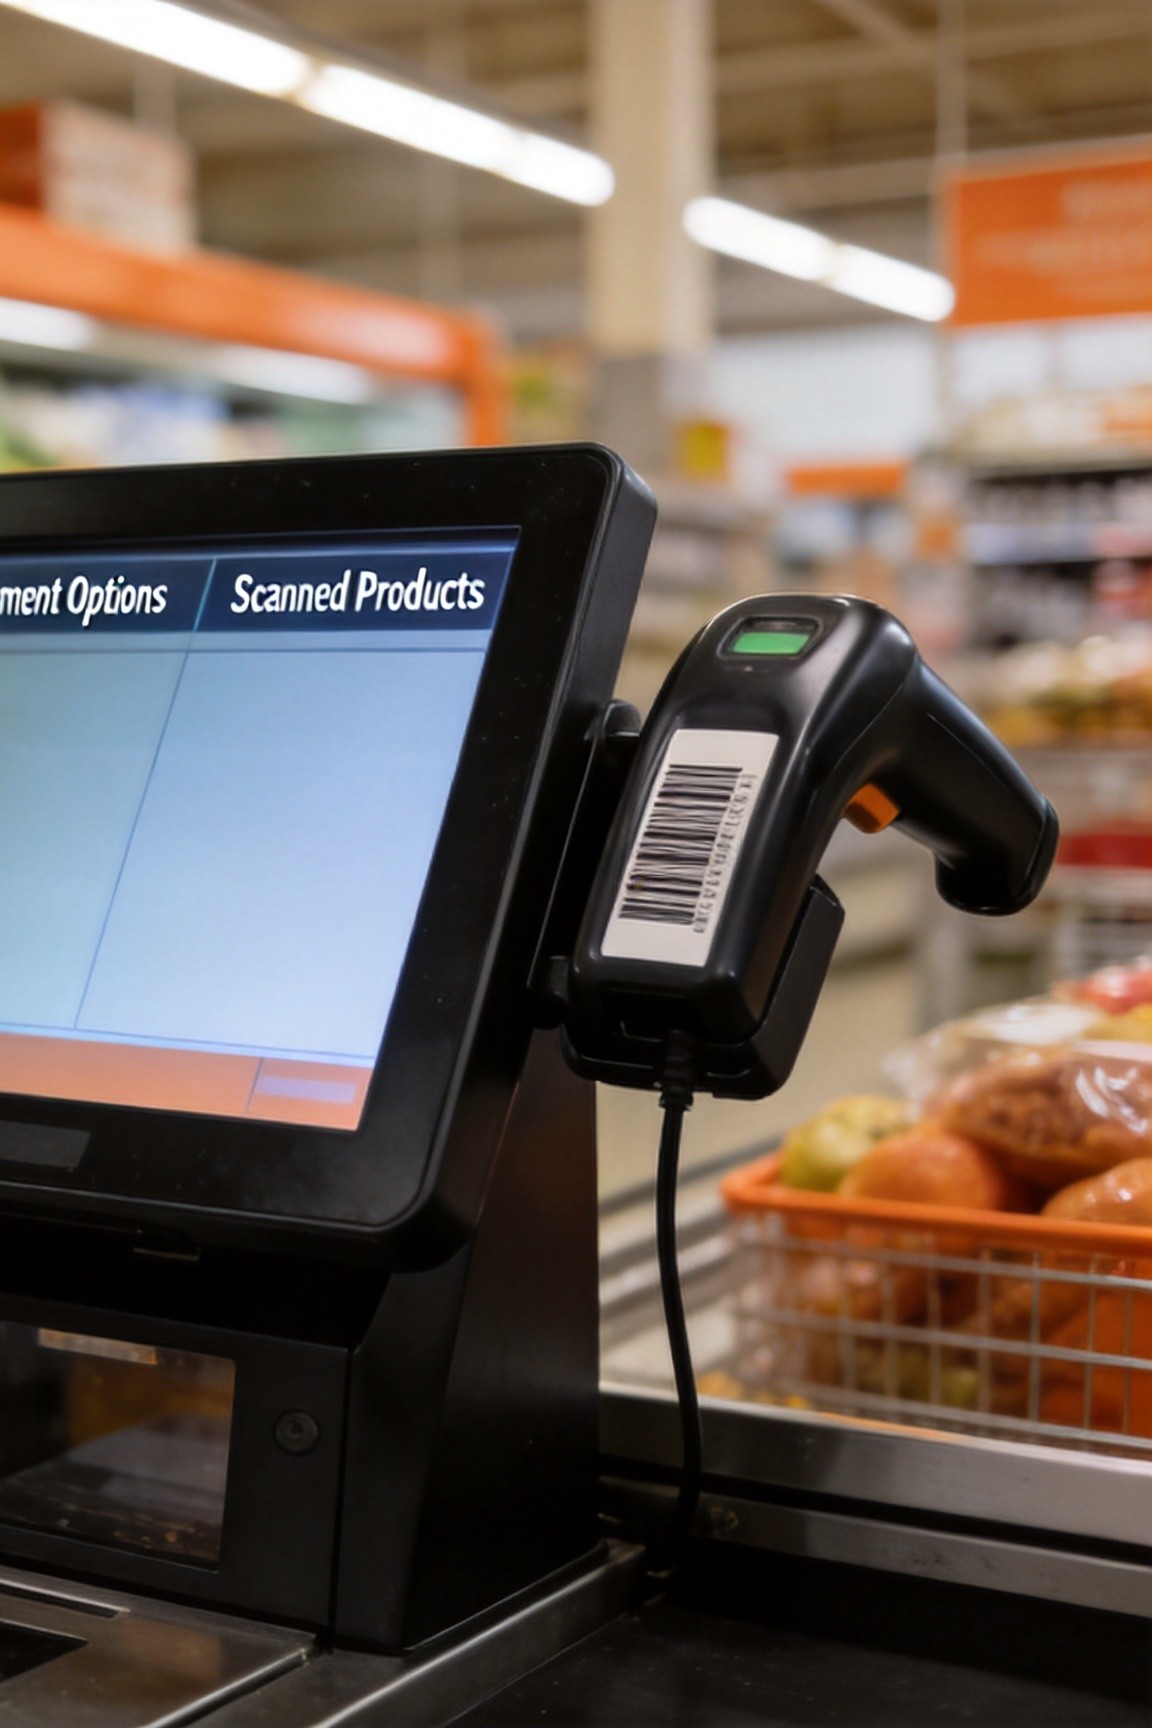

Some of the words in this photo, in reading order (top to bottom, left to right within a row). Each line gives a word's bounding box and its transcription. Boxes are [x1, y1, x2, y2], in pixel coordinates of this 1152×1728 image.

[67, 575, 168, 627] Options
[230, 569, 351, 613] Scanned
[354, 567, 485, 612] Products
